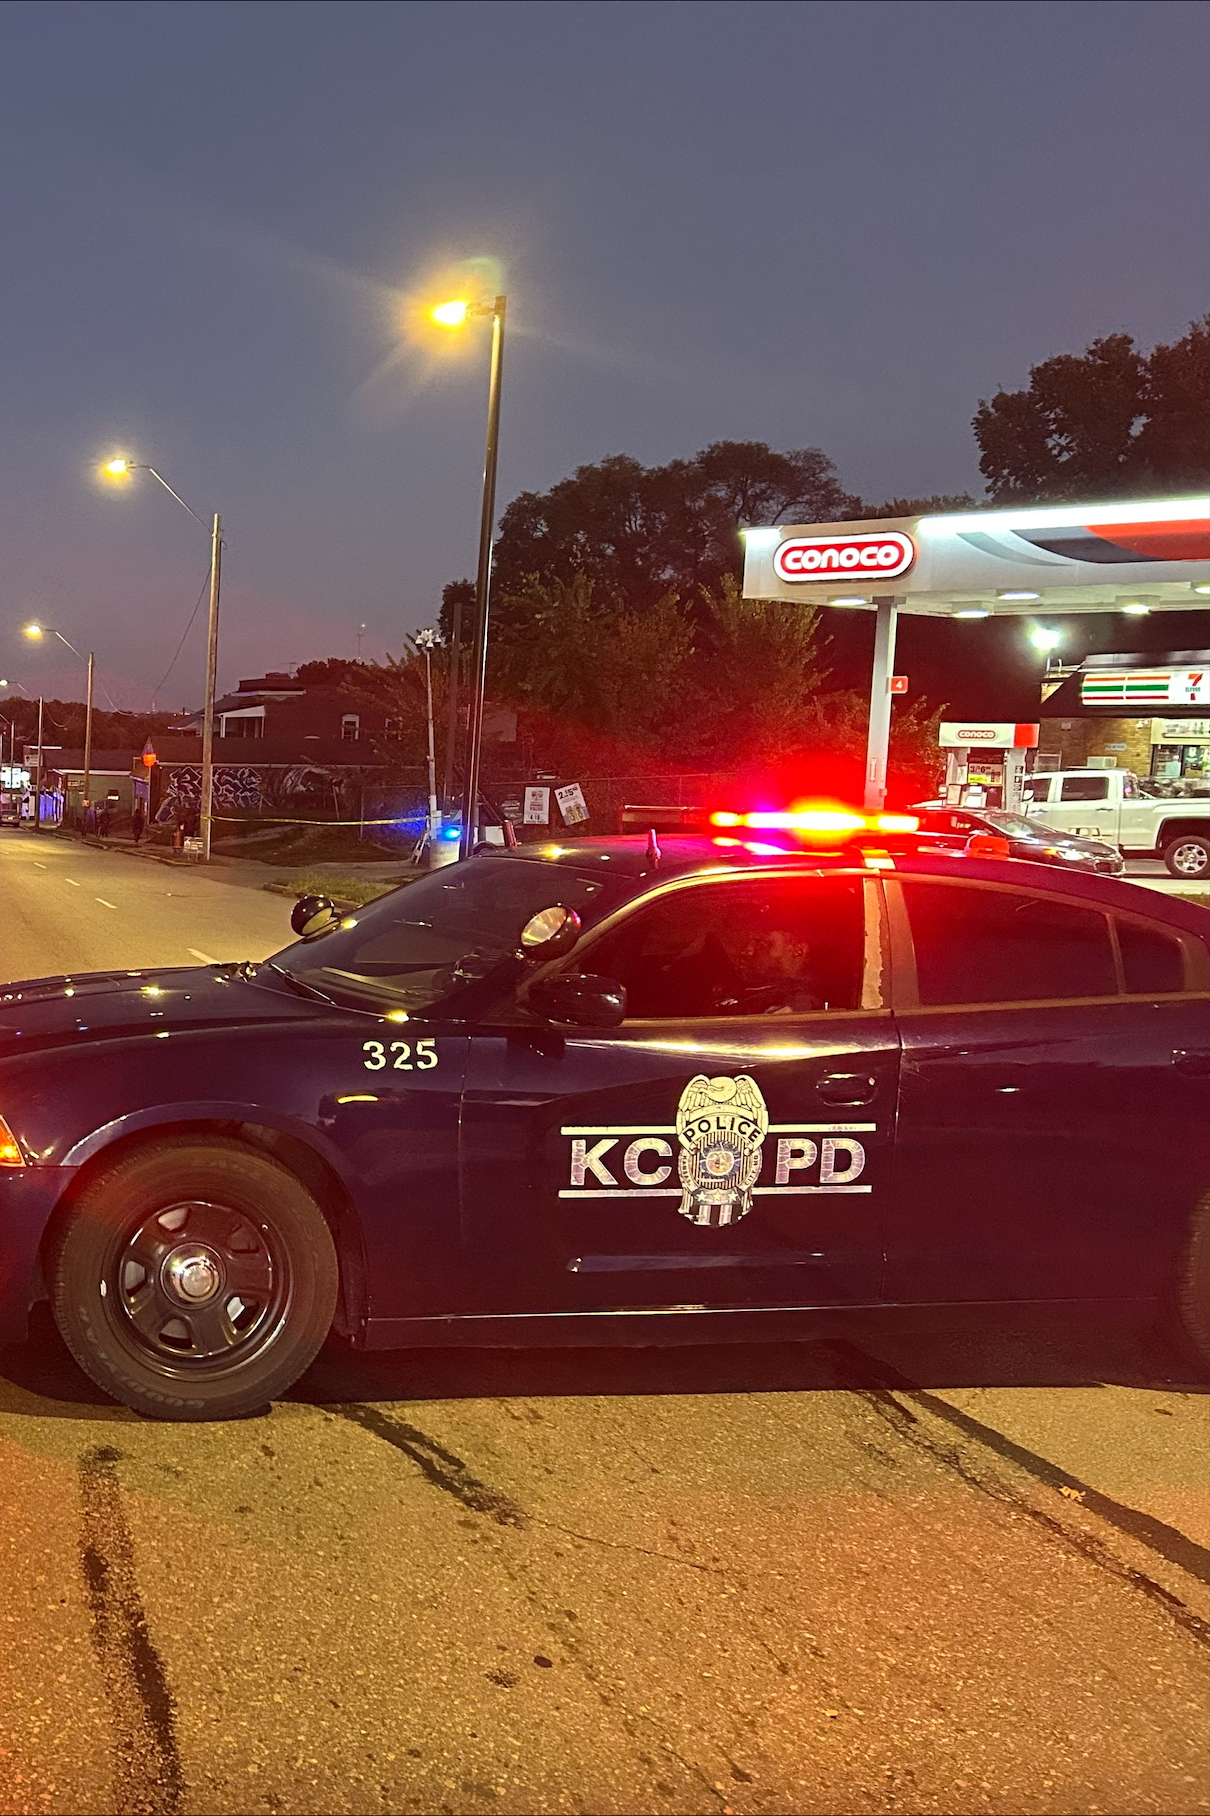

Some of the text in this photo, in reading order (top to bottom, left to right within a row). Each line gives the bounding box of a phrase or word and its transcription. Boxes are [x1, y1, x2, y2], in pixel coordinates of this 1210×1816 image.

[895, 680, 903, 689] 4
[362, 1037, 439, 1071] 325
[682, 1116, 762, 1143] POLICE
[570, 1137, 866, 1186] KC PD
